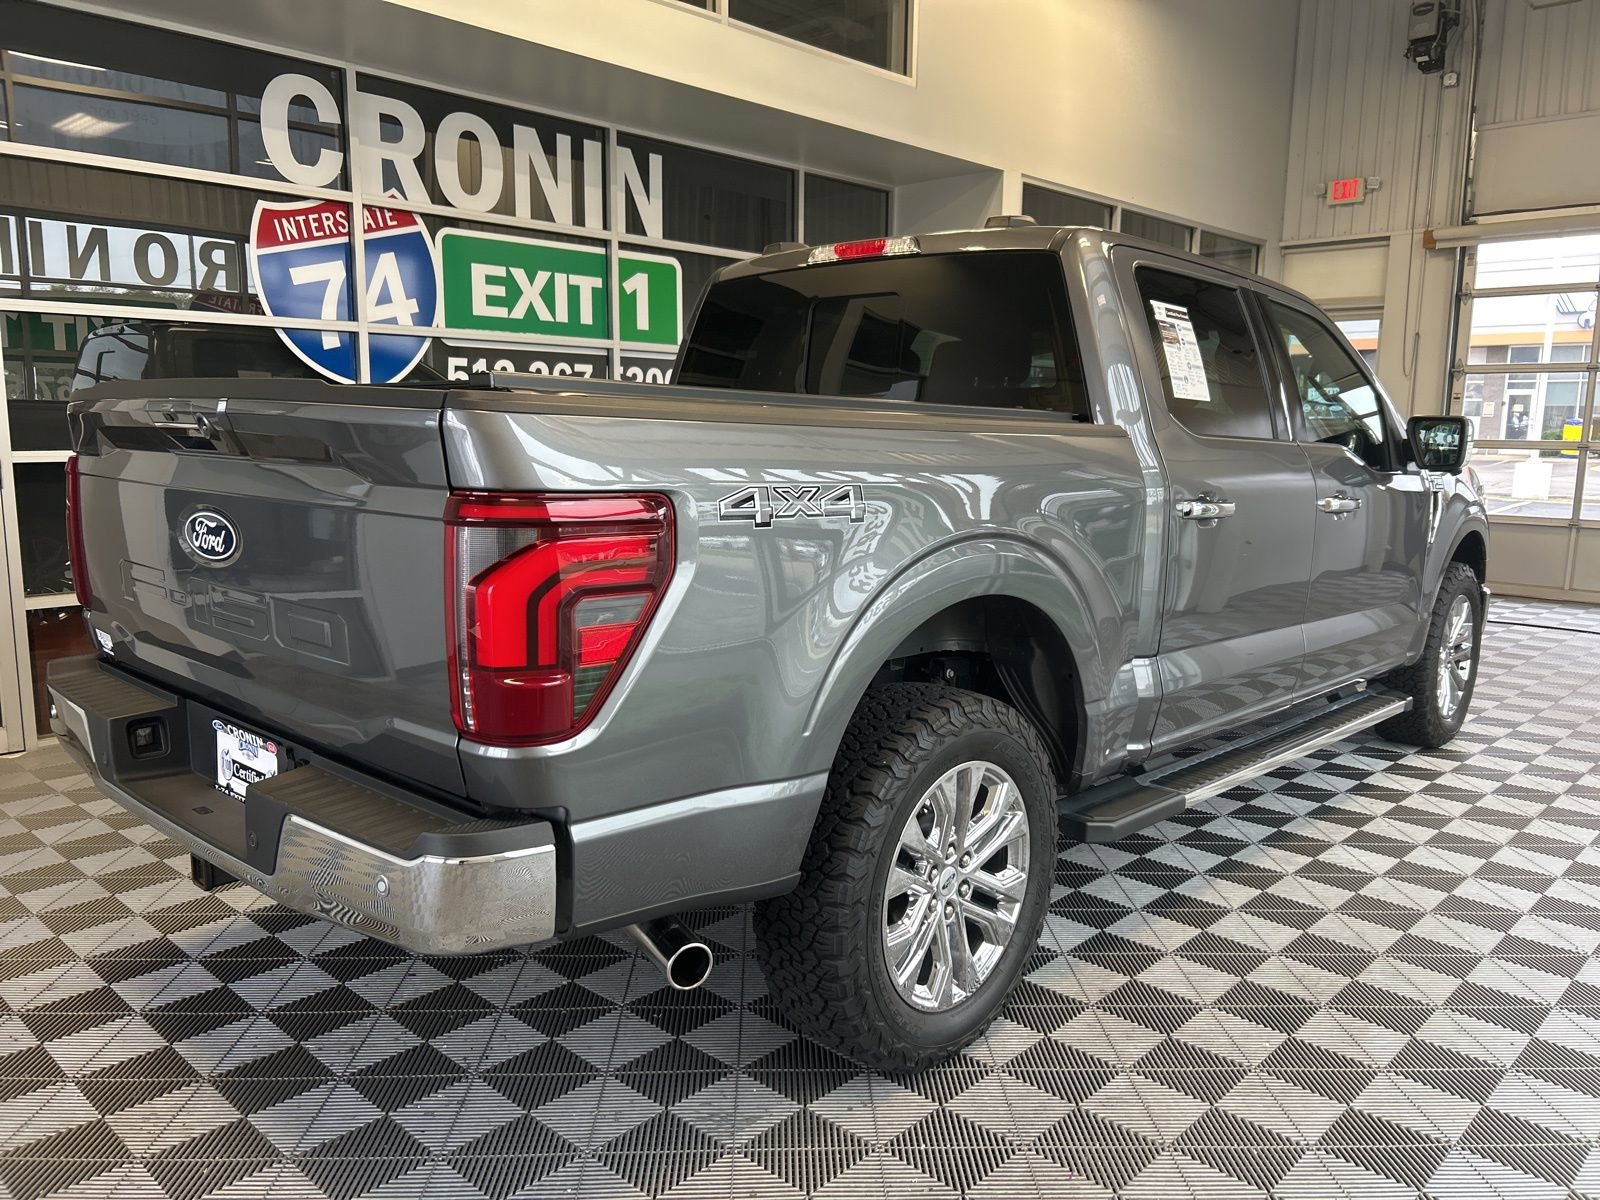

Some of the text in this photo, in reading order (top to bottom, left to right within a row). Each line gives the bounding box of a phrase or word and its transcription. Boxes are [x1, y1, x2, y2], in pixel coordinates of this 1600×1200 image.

[260, 73, 664, 240] CRONIN
[1332, 178, 1360, 201] EXIT
[273, 207, 399, 243] INTERSATE
[289, 251, 419, 351] 74
[470, 261, 650, 332] EXIT 1
[193, 517, 226, 553] Ford
[227, 725, 263, 748] CRONIN
